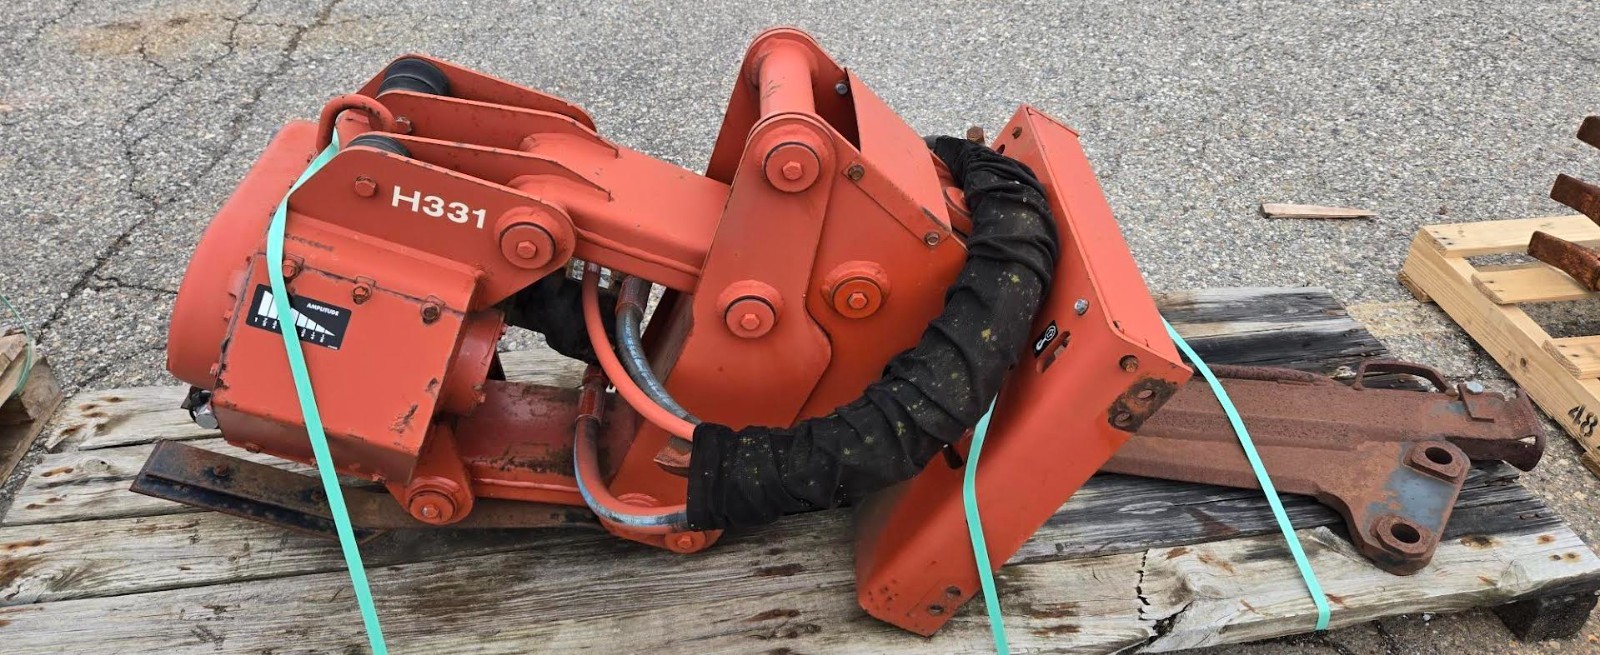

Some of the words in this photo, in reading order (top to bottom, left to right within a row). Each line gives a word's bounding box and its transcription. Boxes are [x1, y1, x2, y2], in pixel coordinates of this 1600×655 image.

[391, 185, 486, 229] H331
[306, 302, 340, 317] AMPLITUDE
[1567, 403, 1599, 438] 48
